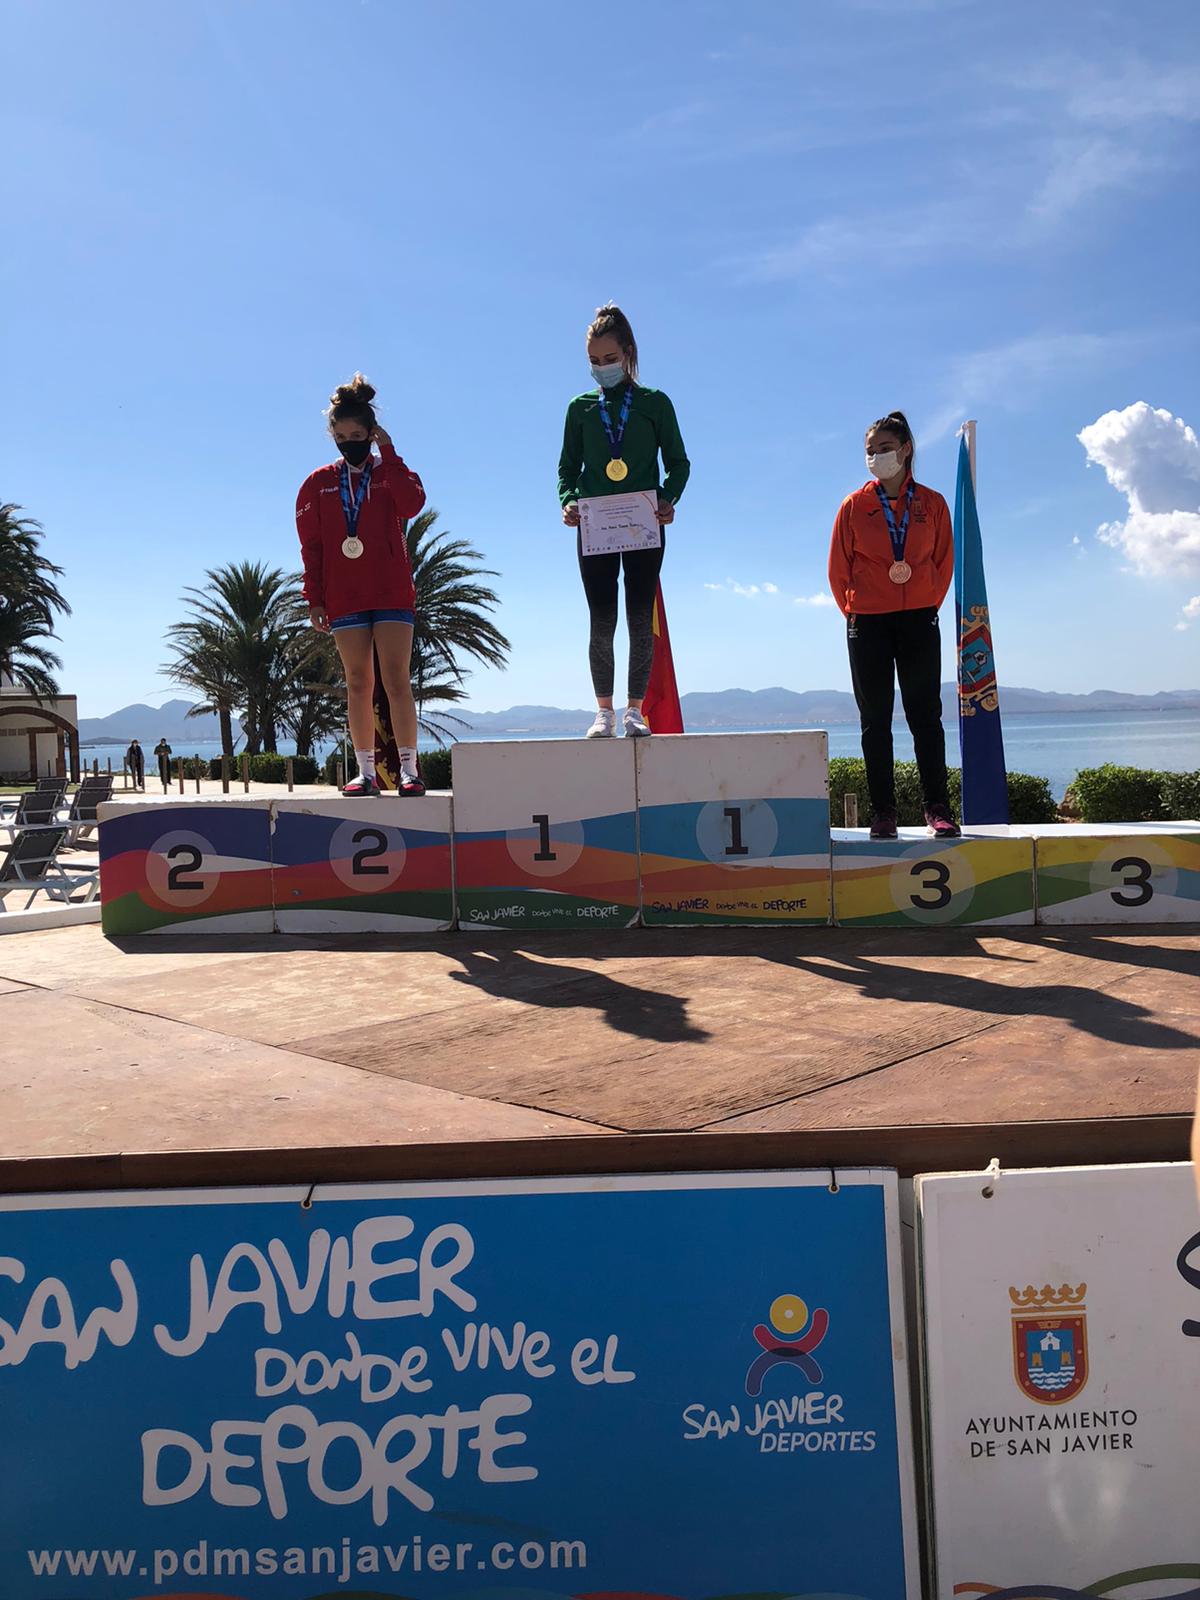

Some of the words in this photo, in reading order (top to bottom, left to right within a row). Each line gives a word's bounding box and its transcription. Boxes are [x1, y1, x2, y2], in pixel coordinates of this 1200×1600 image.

[351, 828, 390, 876] 2
[532, 814, 557, 862] 1
[723, 807, 749, 856] 1
[167, 843, 205, 891] 2
[909, 860, 952, 911] 3
[1110, 856, 1154, 907] 3
[470, 909, 490, 922] SAN
[491, 905, 526, 921] JAVIER
[576, 904, 619, 918] DEPORTE
[652, 901, 672, 914] SAN
[675, 898, 709, 912] JAVIER
[762, 898, 807, 912] DEPORTE
[153, 1215, 477, 1357] JAVIER
[682, 1403, 740, 1440] SAN
[745, 1391, 845, 1436] JAVIER
[965, 1409, 1138, 1435] AYUNTAMIENTO
[140, 1393, 539, 1527] DEPORTE
[760, 1430, 876, 1453] DEPORTES
[970, 1441, 996, 1458] DE
[1007, 1437, 1051, 1456] SAN
[1061, 1433, 1134, 1453] JAVIER
[27, 1540, 588, 1585] www.pdmsanjavier.com
